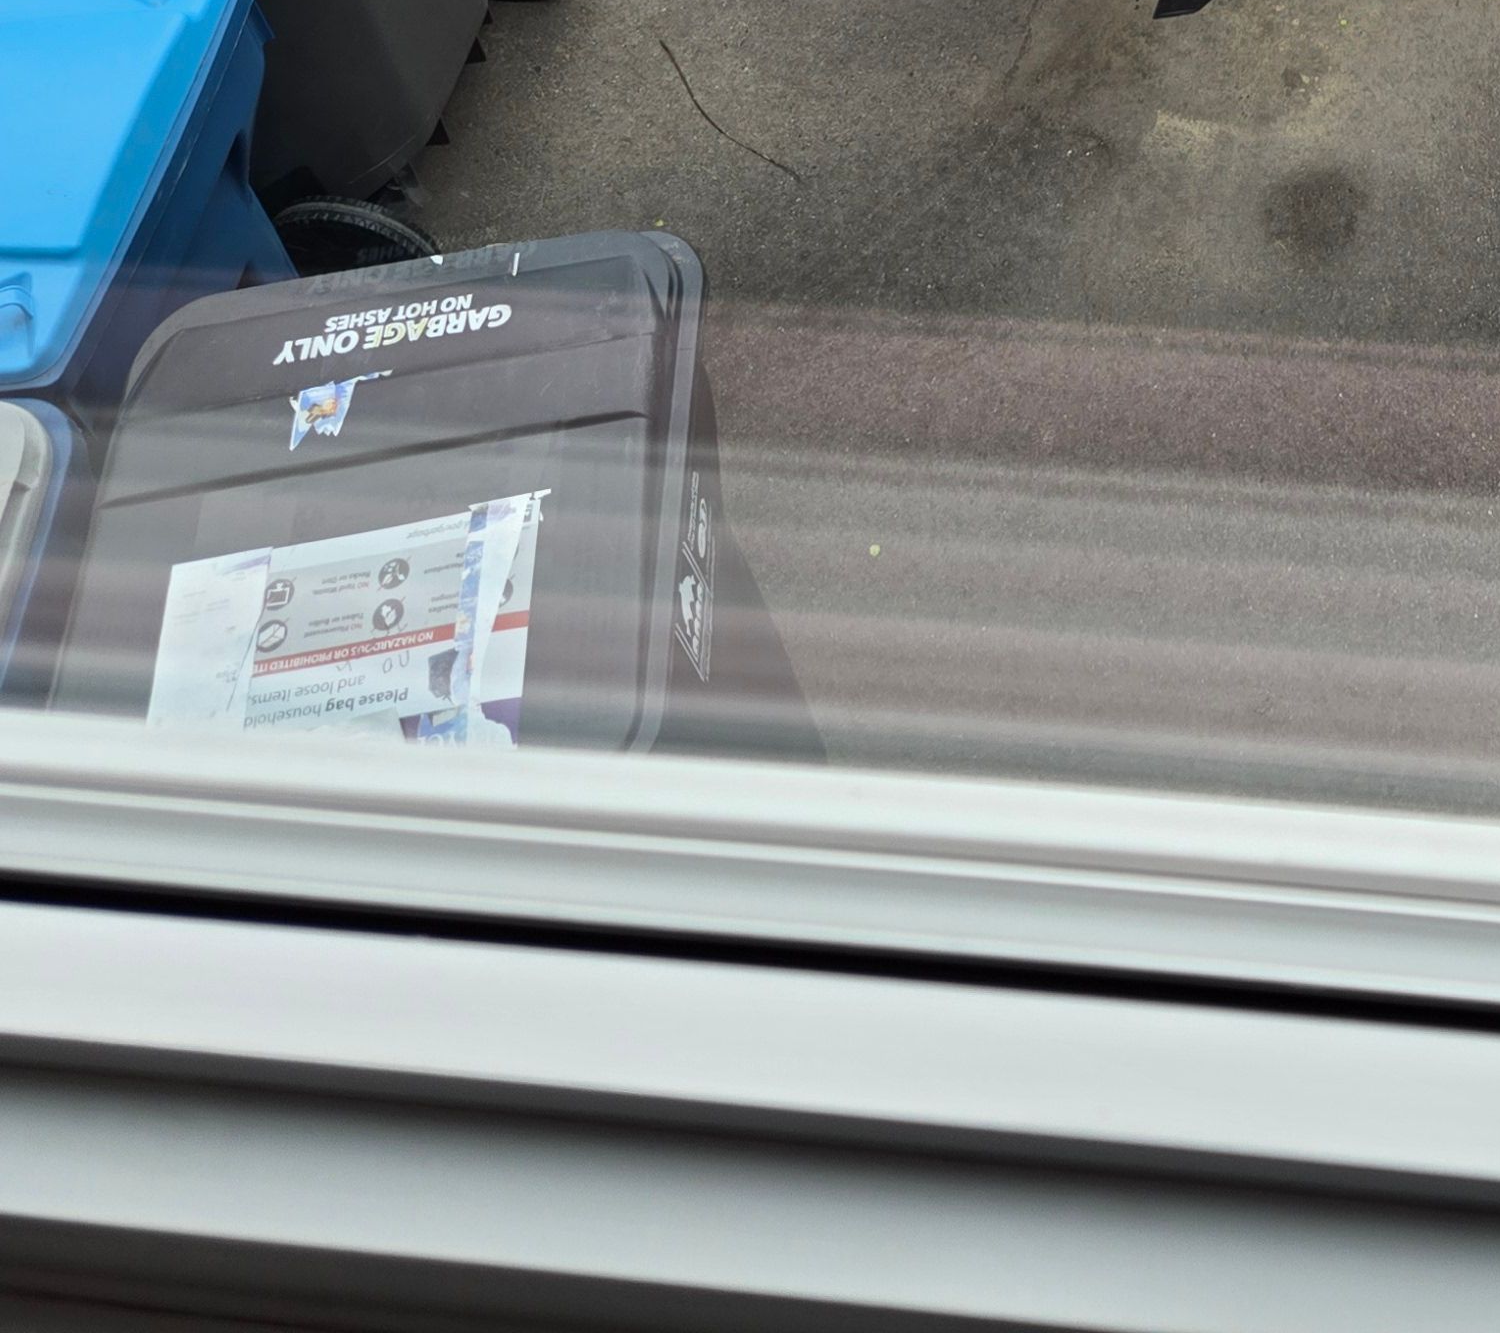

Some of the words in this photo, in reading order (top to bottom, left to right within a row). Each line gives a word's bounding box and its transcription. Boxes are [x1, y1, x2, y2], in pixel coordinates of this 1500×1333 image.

[392, 299, 438, 321] HOT
[440, 293, 473, 311] NO
[324, 306, 393, 333] ASHES
[363, 303, 513, 349] GARBAGE
[272, 329, 360, 366] ONLY
[417, 631, 435, 642] NO
[269, 650, 334, 671] PROHIBITED
[334, 648, 350, 659] OR
[294, 681, 334, 698] loose
[337, 674, 367, 692] and
[324, 697, 355, 712] bag
[358, 687, 409, 706] Please
[242, 703, 322, 729] household
